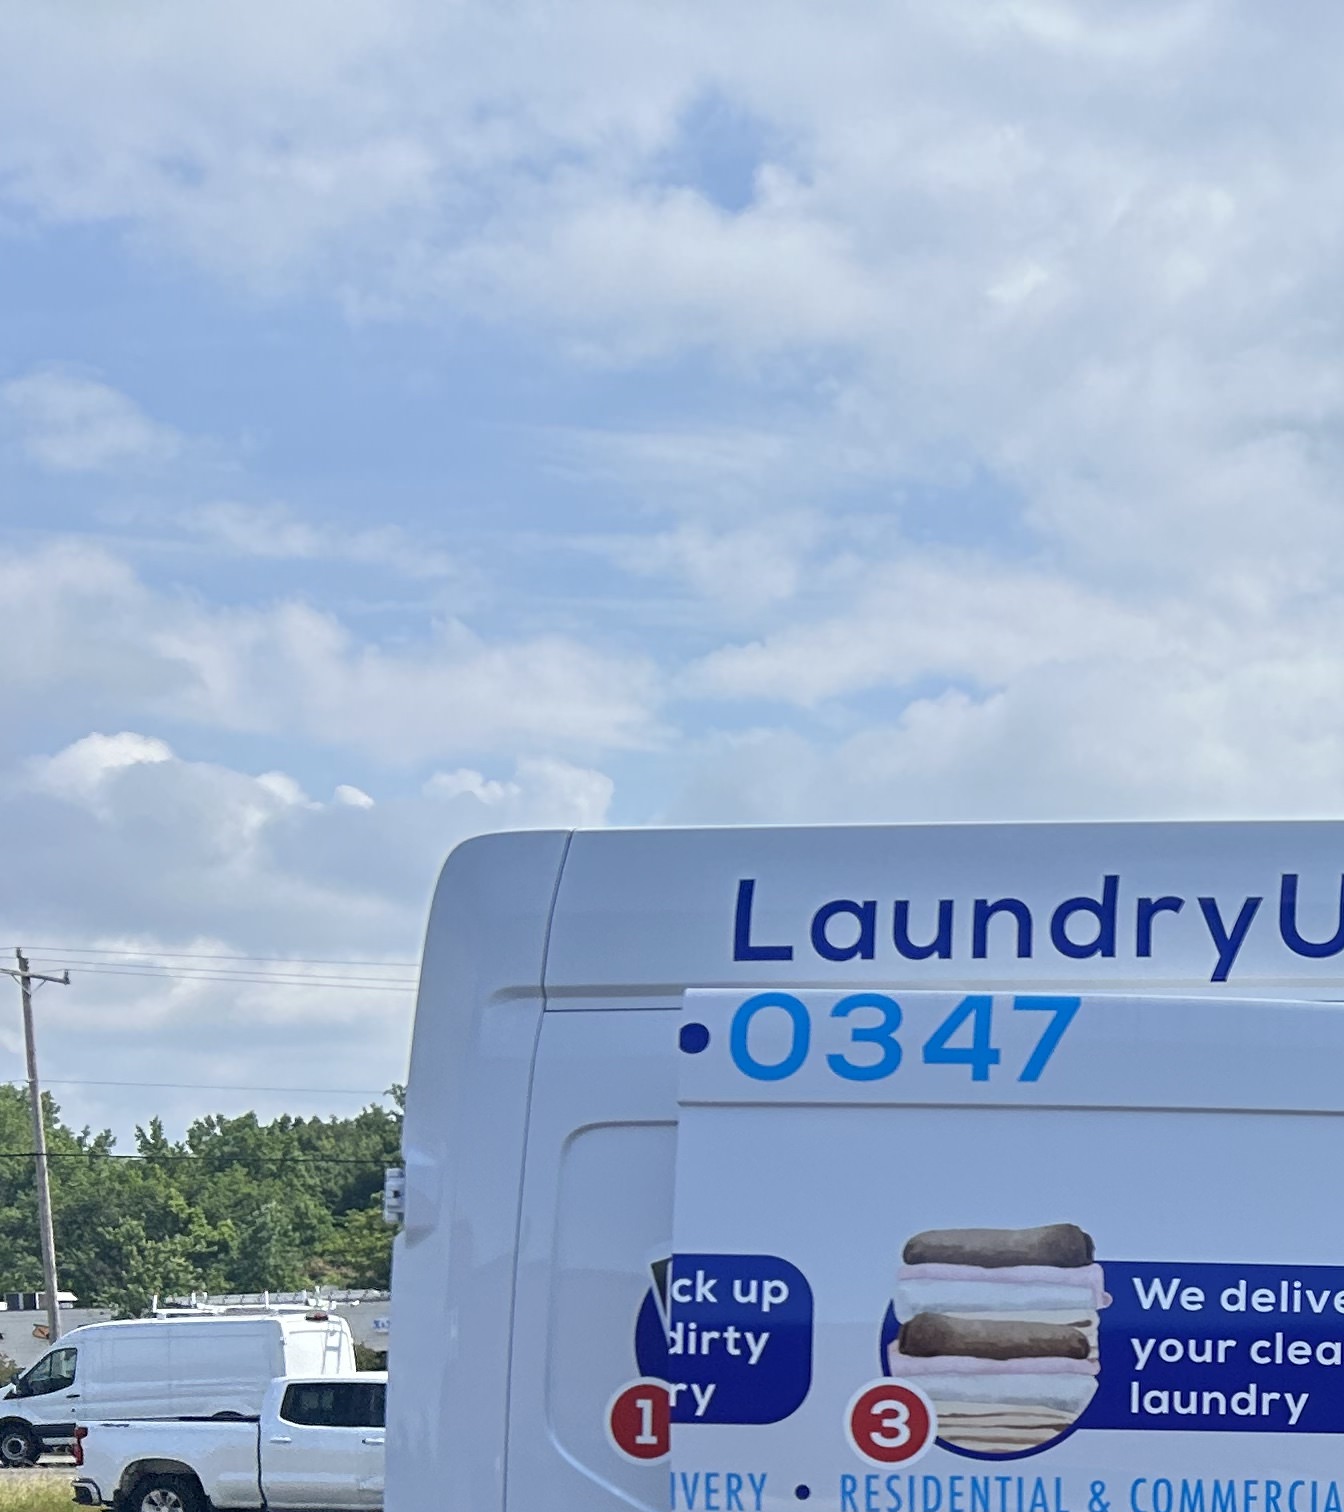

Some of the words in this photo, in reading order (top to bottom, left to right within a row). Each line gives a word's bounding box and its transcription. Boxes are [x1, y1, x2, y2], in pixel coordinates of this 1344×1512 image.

[729, 993, 1083, 1083] 0347
[733, 1279, 790, 1312] up
[1131, 1278, 1205, 1313] We
[668, 1322, 770, 1365] dirty
[1130, 1335, 1243, 1372] your
[636, 1400, 658, 1445] 1
[869, 1400, 911, 1448] 3
[1130, 1382, 1309, 1425] laundry
